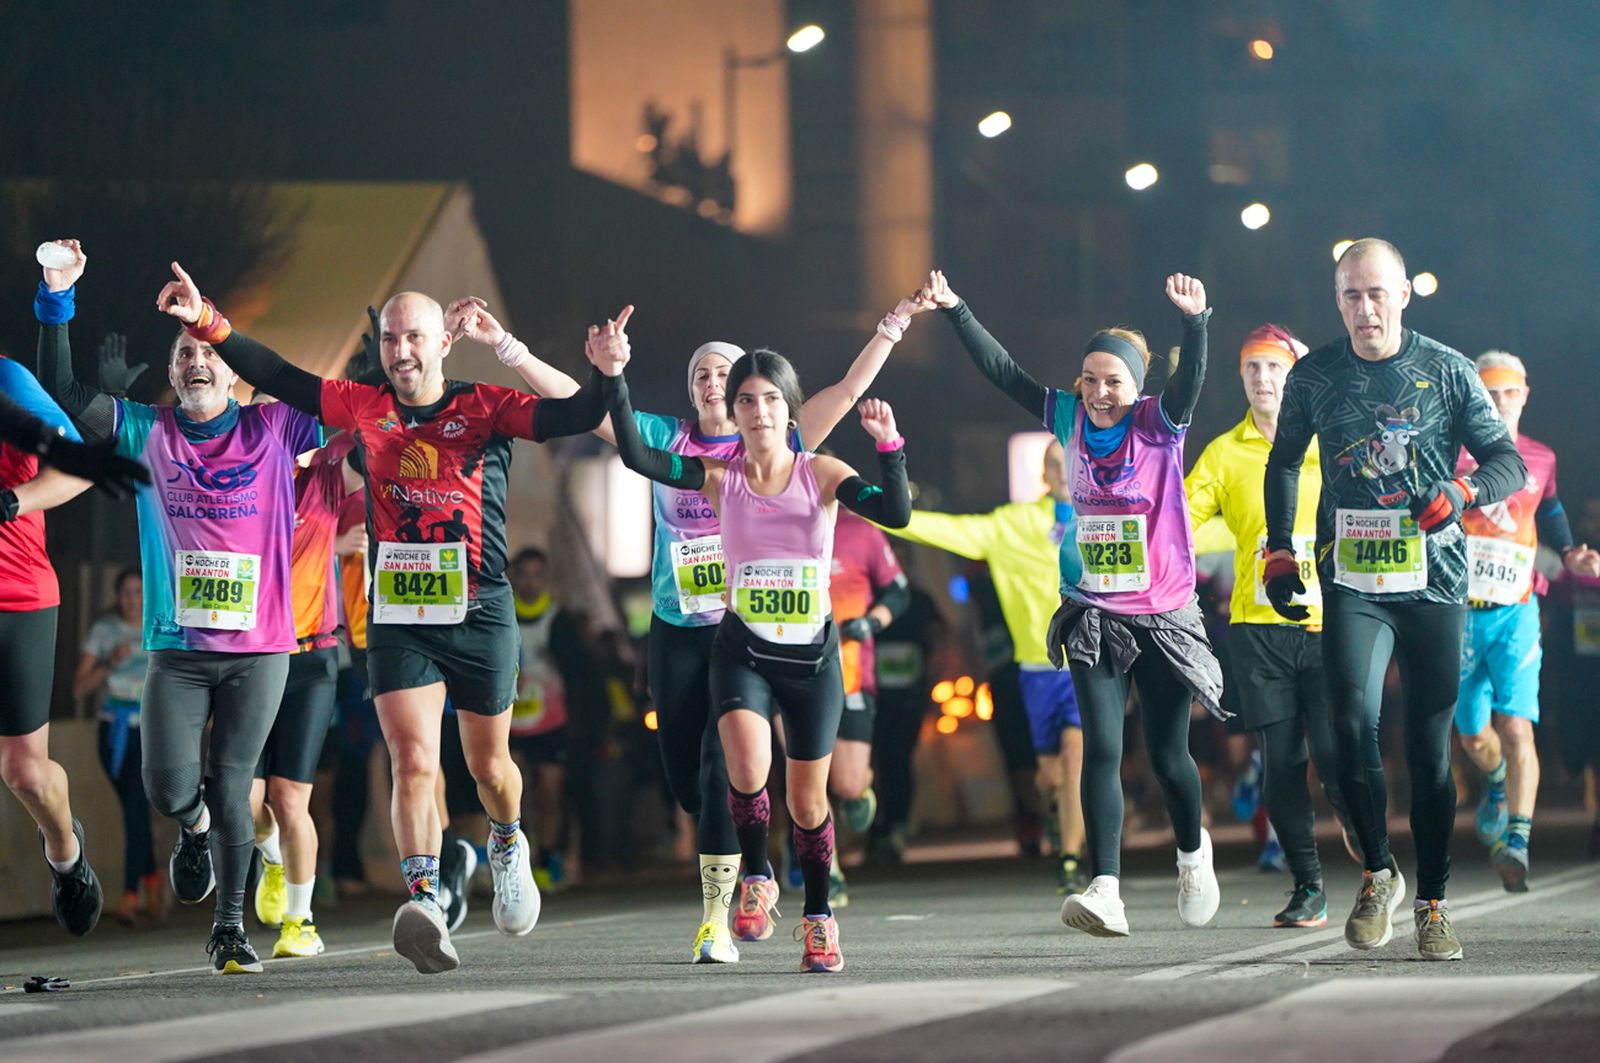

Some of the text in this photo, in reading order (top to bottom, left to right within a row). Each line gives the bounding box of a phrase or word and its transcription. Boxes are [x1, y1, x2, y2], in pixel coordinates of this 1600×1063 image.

[167, 490, 258, 505] CLUB ATLETISMO
[675, 496, 700, 507] CLUB
[167, 503, 258, 519] SALOBREÑA
[1106, 523, 1116, 531] DE
[1355, 519, 1378, 528] NOCHE
[1380, 519, 1391, 528] DE
[1091, 531, 1116, 542] ANTÓN
[1345, 528, 1363, 538] SAN
[1364, 526, 1392, 538] ANTÓN
[691, 546, 716, 555] NOCHE
[1084, 542, 1132, 566] 3233
[1353, 540, 1407, 565] 1446
[393, 552, 431, 561] NOCHE DE
[682, 552, 724, 566] SAN ANTÓ
[194, 559, 219, 568] NOCHE
[220, 560, 230, 568] DE
[384, 561, 401, 571] SAN
[402, 559, 432, 571] ANTÓN
[185, 567, 229, 578] SAN ANTÓN
[753, 568, 782, 578] NOCHE
[783, 568, 794, 577] DE
[393, 572, 448, 596] 8421
[743, 578, 794, 588] SAN ANTÓN
[191, 577, 243, 604] 2489
[749, 589, 811, 615] 5300
